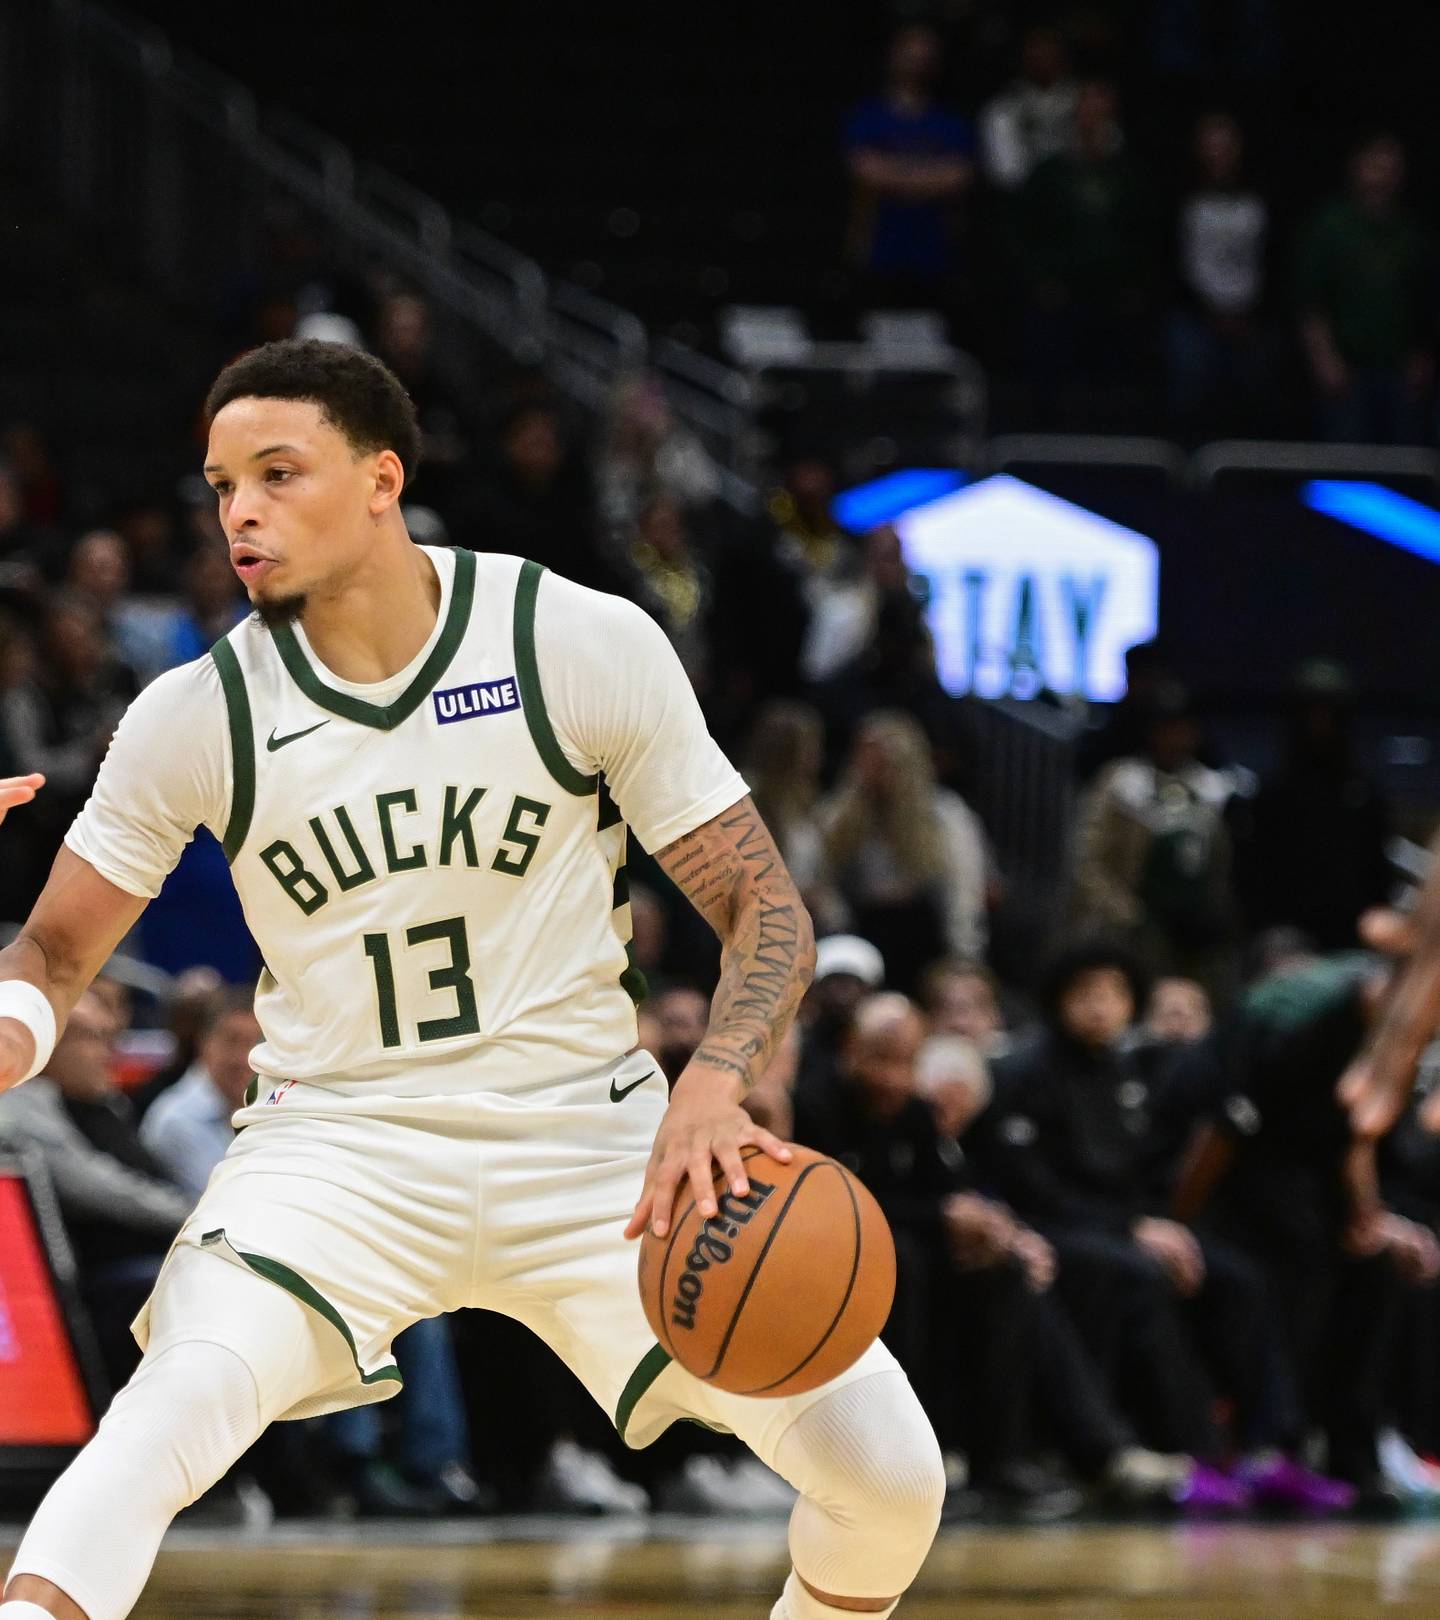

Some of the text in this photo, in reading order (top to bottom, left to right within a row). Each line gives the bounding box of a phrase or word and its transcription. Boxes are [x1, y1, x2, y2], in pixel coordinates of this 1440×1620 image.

[438, 683, 516, 718] ULINE
[257, 784, 553, 918] BUCKS
[362, 915, 481, 1049] 13
[672, 1177, 777, 1330] Wilson
